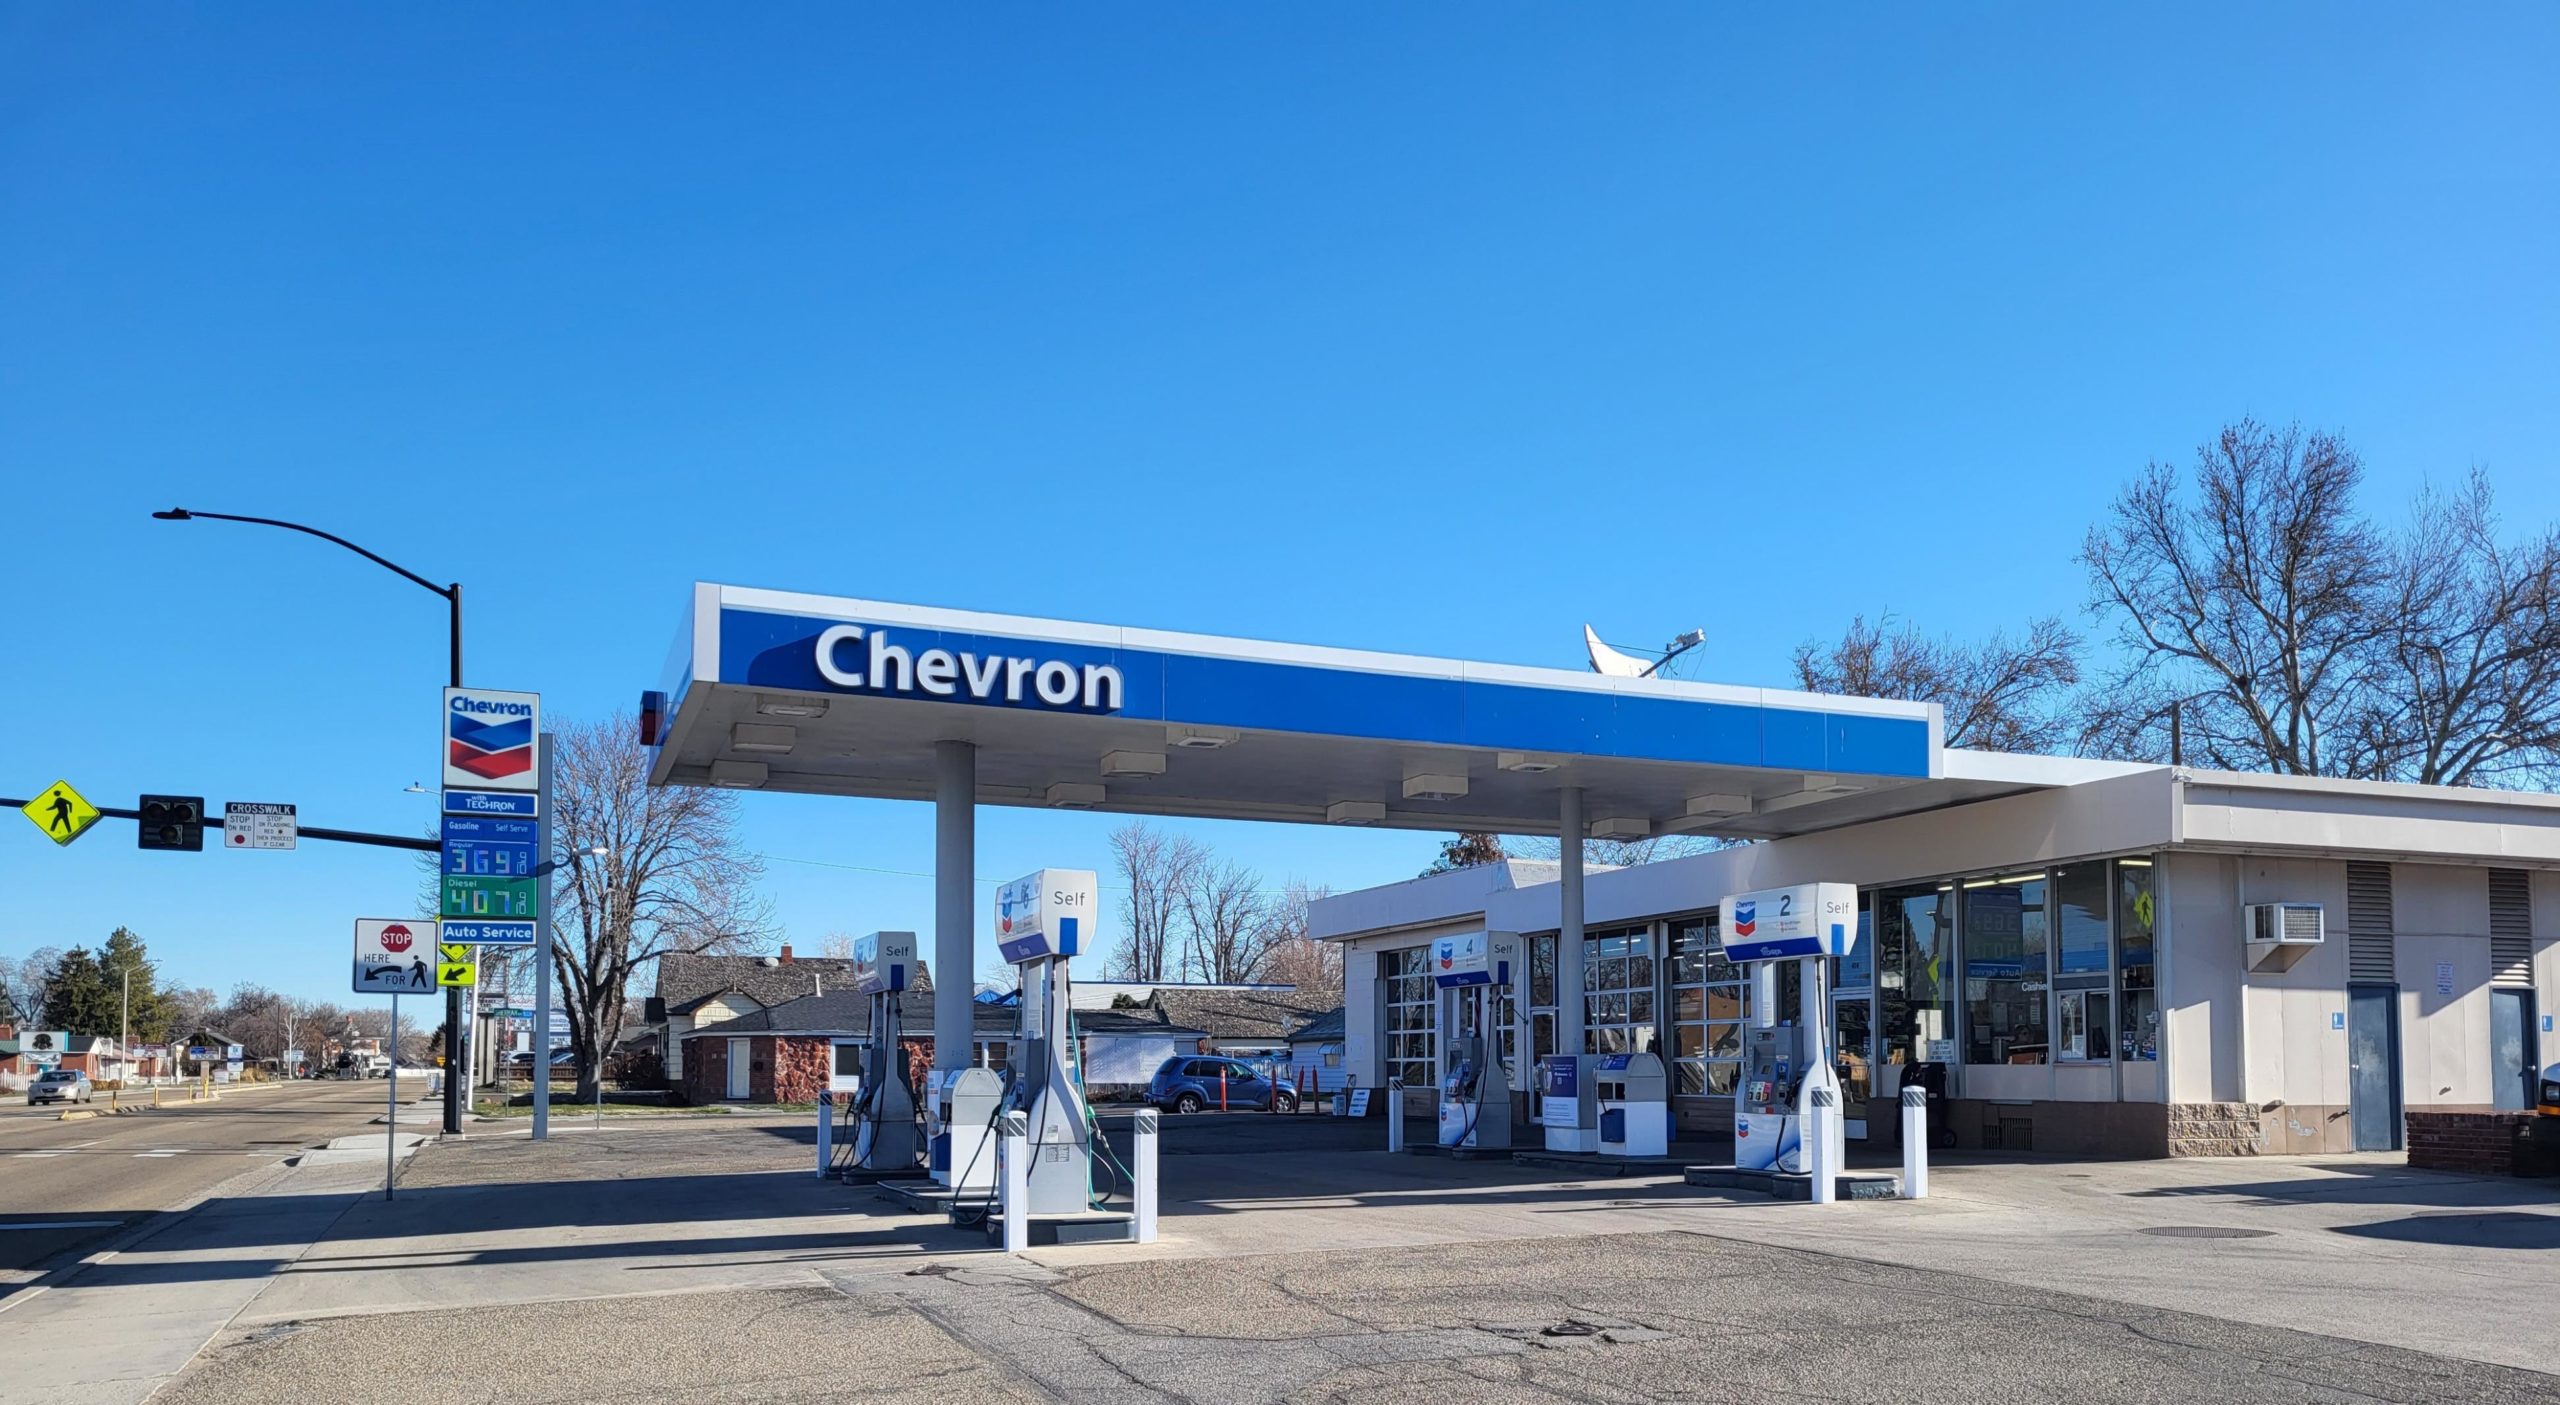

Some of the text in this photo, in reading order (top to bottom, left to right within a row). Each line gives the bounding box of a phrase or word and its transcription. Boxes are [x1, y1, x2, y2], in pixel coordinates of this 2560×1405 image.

[815, 624, 1124, 709] Chevron
[450, 696, 532, 717] Chevron
[471, 794, 487, 802] with
[231, 804, 291, 815] CROSSWALK
[465, 798, 516, 812] TECHRON
[449, 821, 529, 833] Gasoline Self Serve
[449, 841, 474, 849] Regular
[448, 879, 477, 888] Diesel
[1053, 890, 1087, 907] Self
[1779, 894, 1791, 917] 2
[1826, 901, 1850, 914] Self
[444, 926, 532, 939] Auto Service
[382, 933, 412, 945] STOP
[885, 945, 909, 957] Self
[1466, 938, 1473, 955] 4
[1494, 943, 1513, 955] Self
[364, 953, 391, 964] HERE
[385, 975, 406, 985] FOR
[2021, 982, 2048, 992] Cashie
